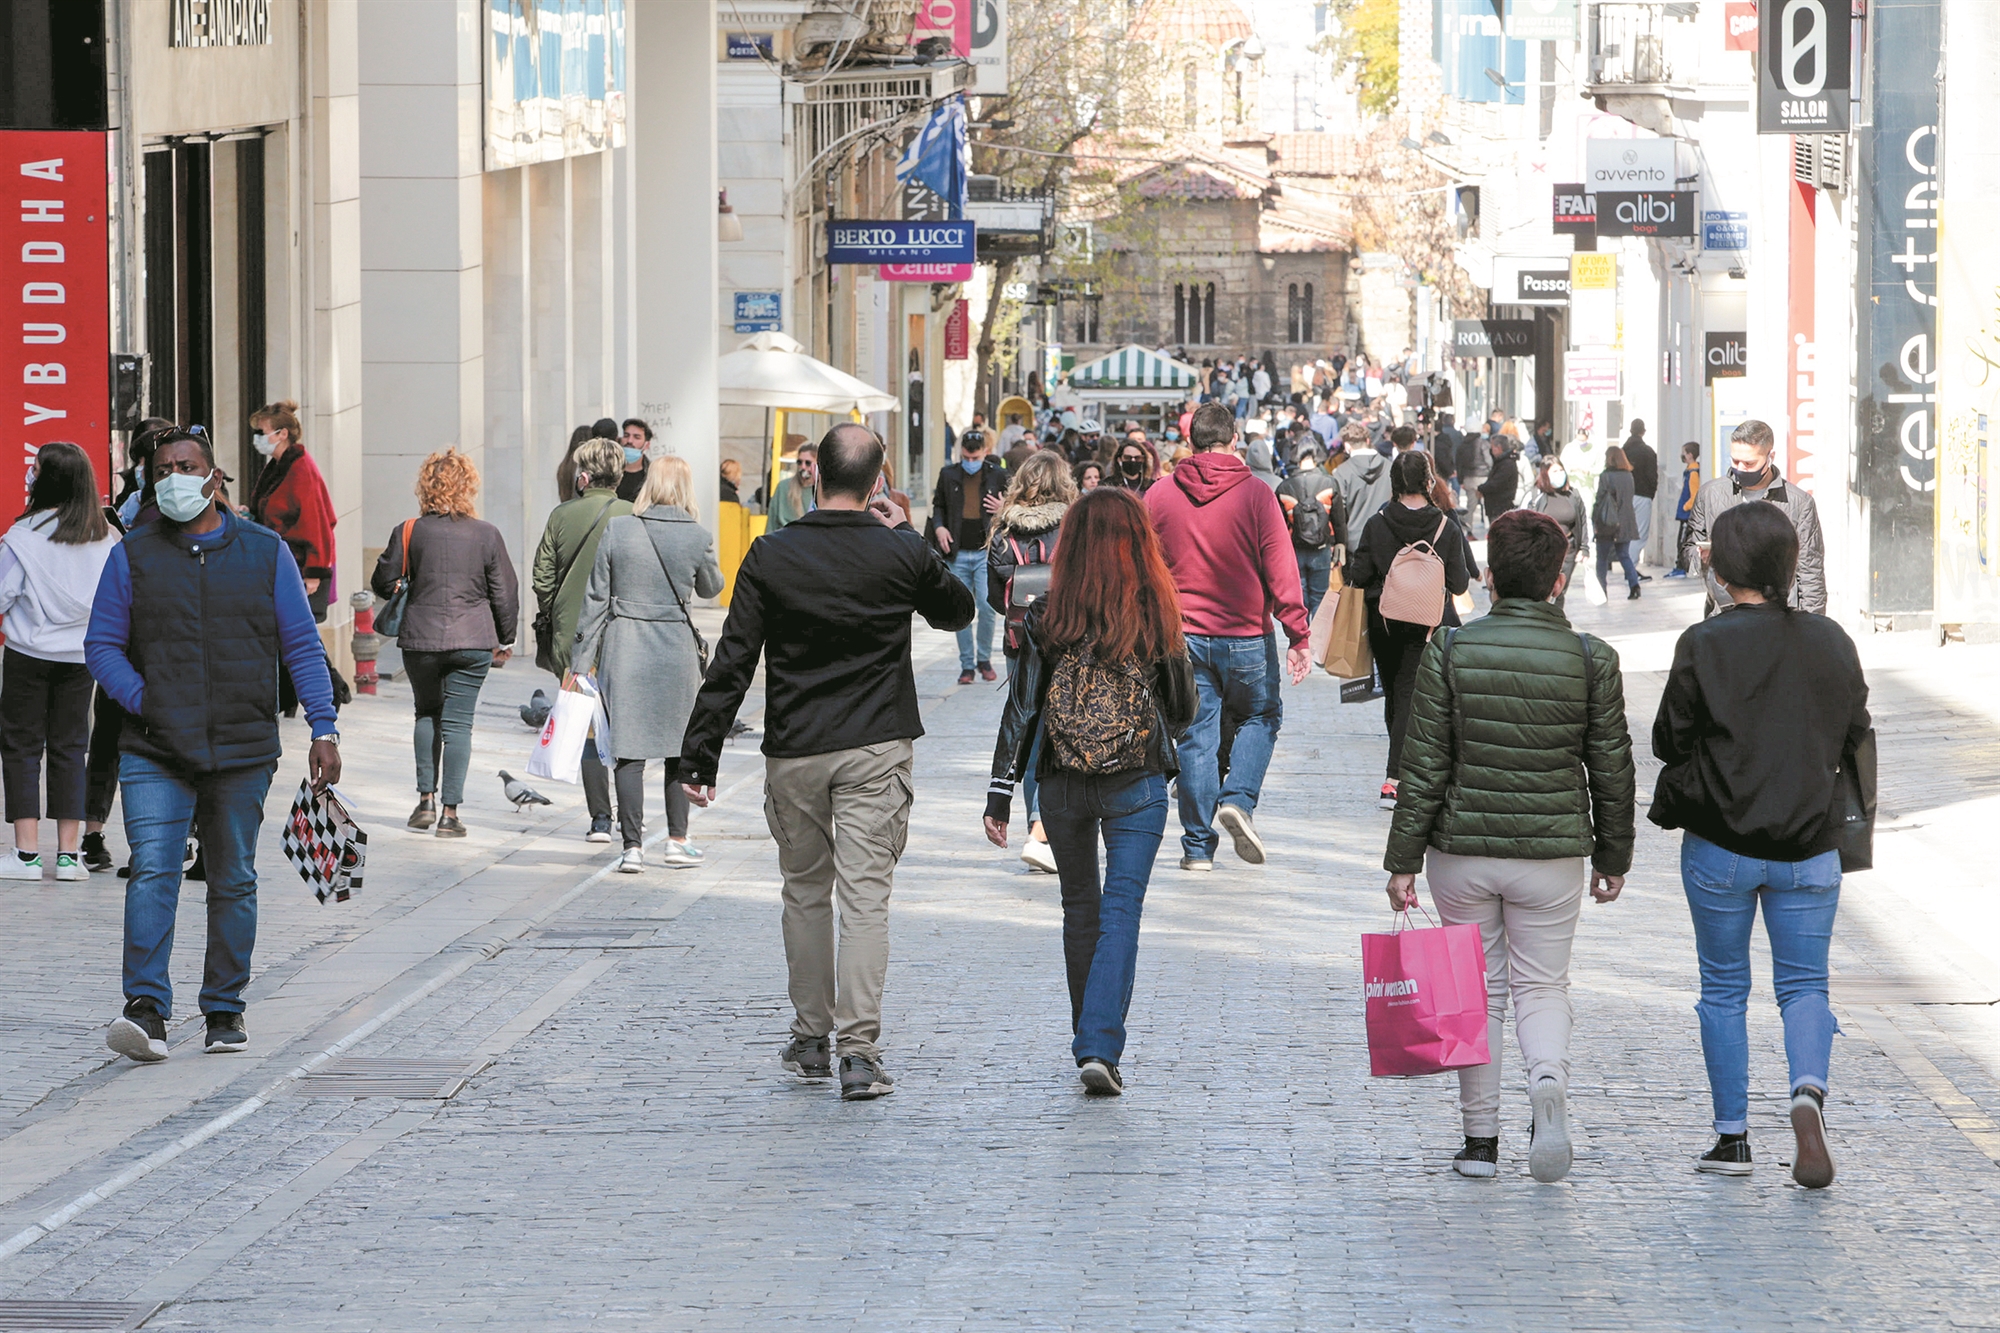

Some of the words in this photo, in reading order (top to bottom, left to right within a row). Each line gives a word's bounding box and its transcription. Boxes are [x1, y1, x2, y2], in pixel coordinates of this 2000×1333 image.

[1781, 100, 1828, 118] SALON
[1595, 167, 1665, 181] avvento
[1616, 194, 1675, 223] alibi
[1632, 224, 1658, 233] bags
[1715, 224, 1739, 232] ΟΔΟΣ
[834, 229, 896, 245] BERTO
[908, 229, 963, 245] LUCCI
[1580, 256, 1608, 266] ΑΓΟΡΑ
[1577, 267, 1611, 275] ΧΡΥΣΟΥ
[1457, 332, 1528, 346] ROMANO
